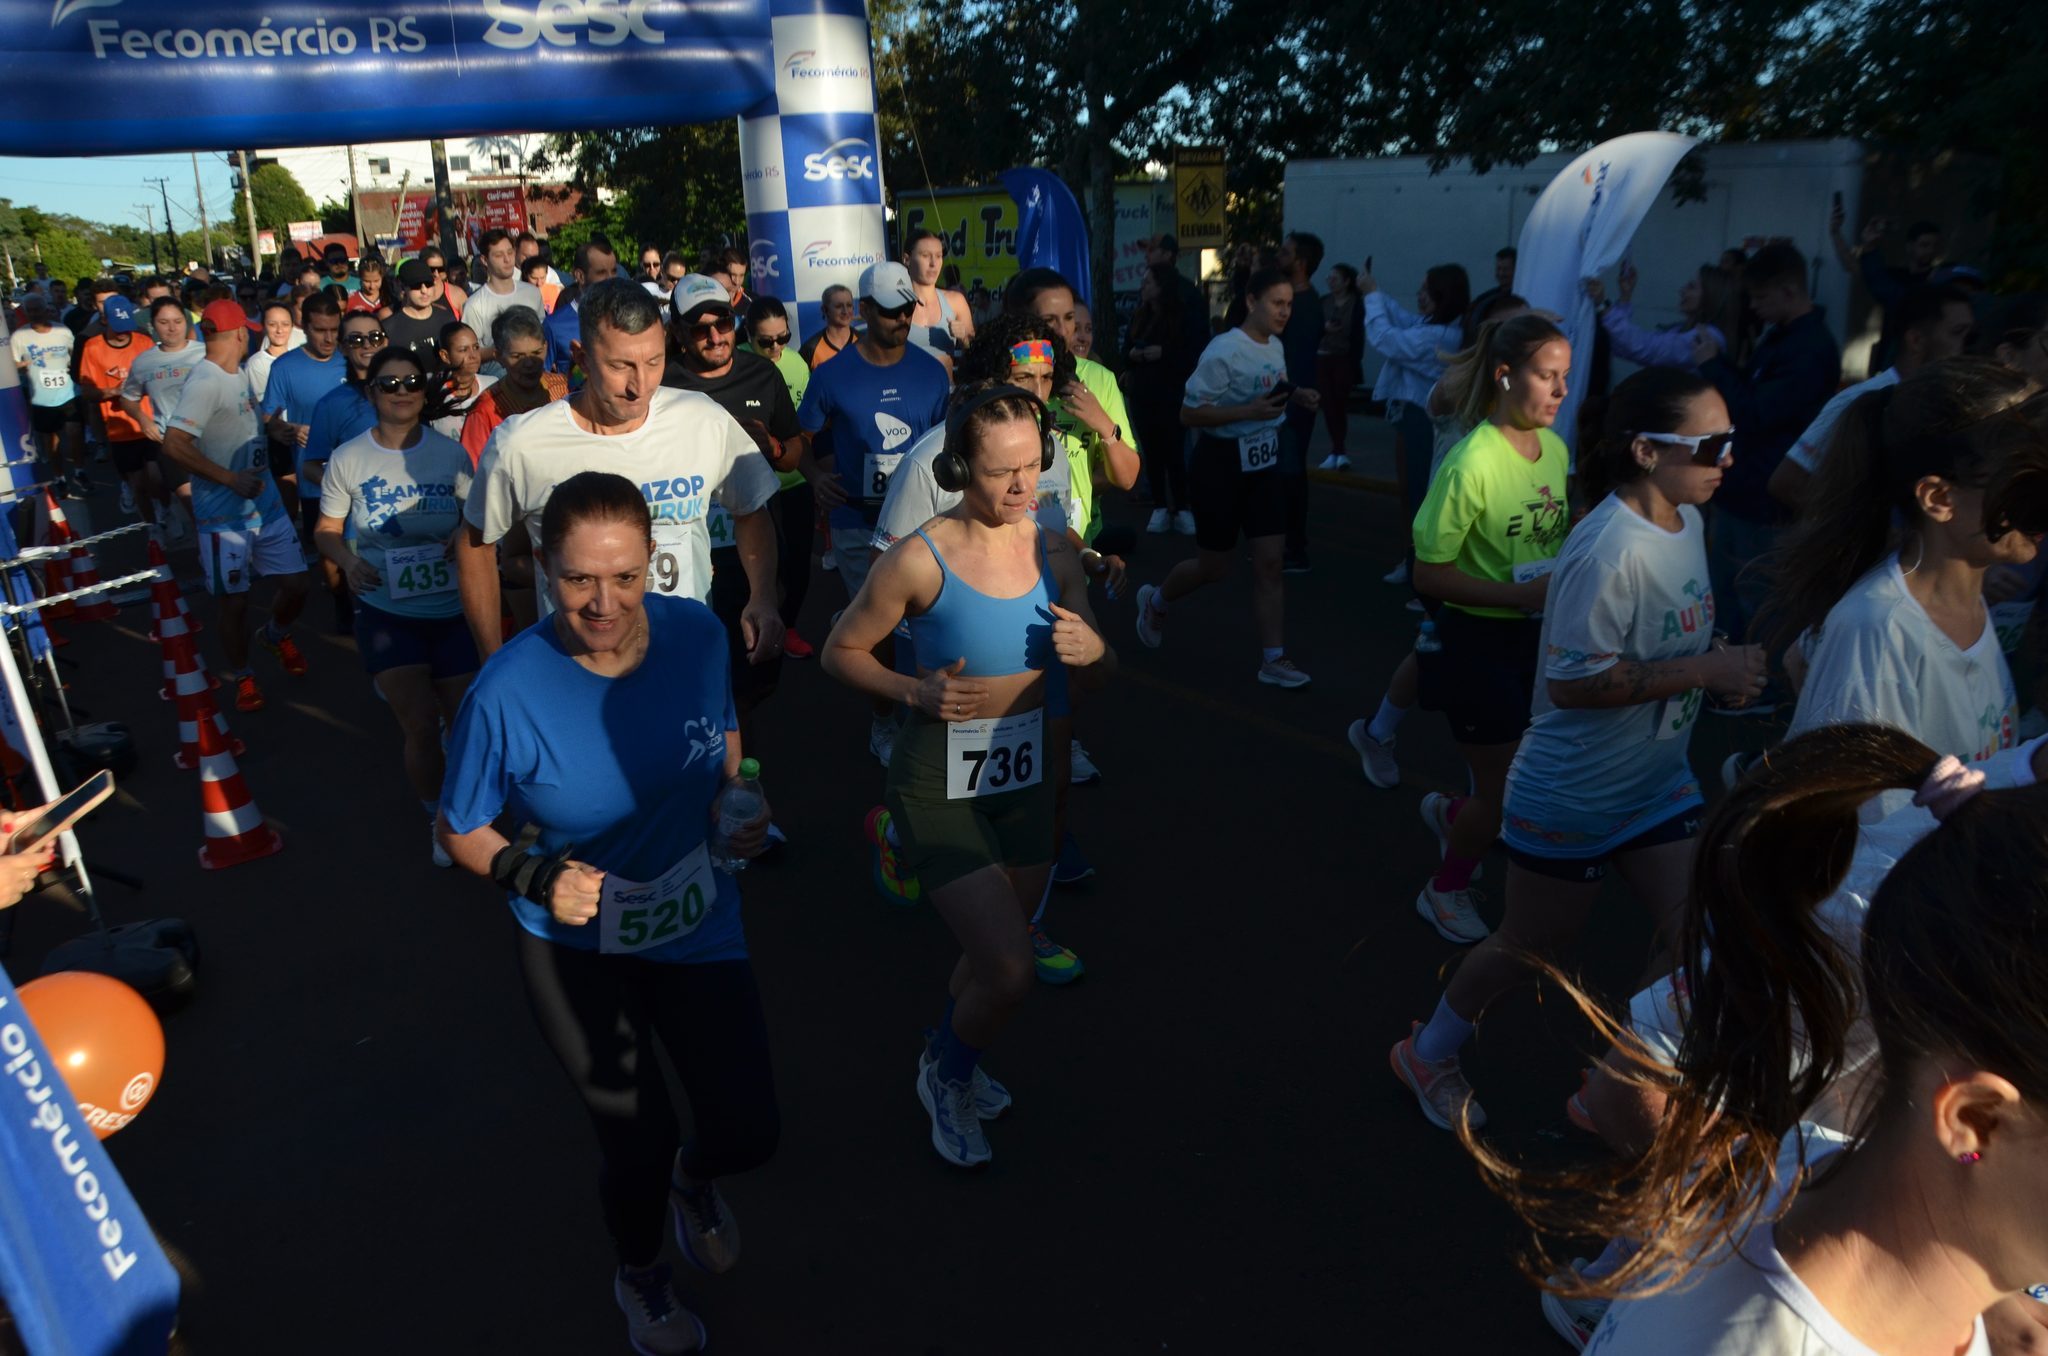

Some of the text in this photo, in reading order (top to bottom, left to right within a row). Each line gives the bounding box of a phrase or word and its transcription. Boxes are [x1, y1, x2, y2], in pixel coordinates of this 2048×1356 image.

[88, 16, 426, 59] Fecomércio RS
[482, 0, 666, 49] Sesc
[791, 65, 870, 79] Fecomércio RS
[803, 153, 873, 182] Sesc
[808, 252, 874, 268] Fecomércio
[44, 377, 66, 388] 613
[745, 399, 761, 407] FILA
[1248, 442, 1280, 468] 684
[398, 560, 450, 592] 435
[962, 740, 1033, 791] 736
[614, 890, 657, 905] Sesc
[617, 882, 705, 946] 520
[1, 1023, 138, 1282] Fecomércio
